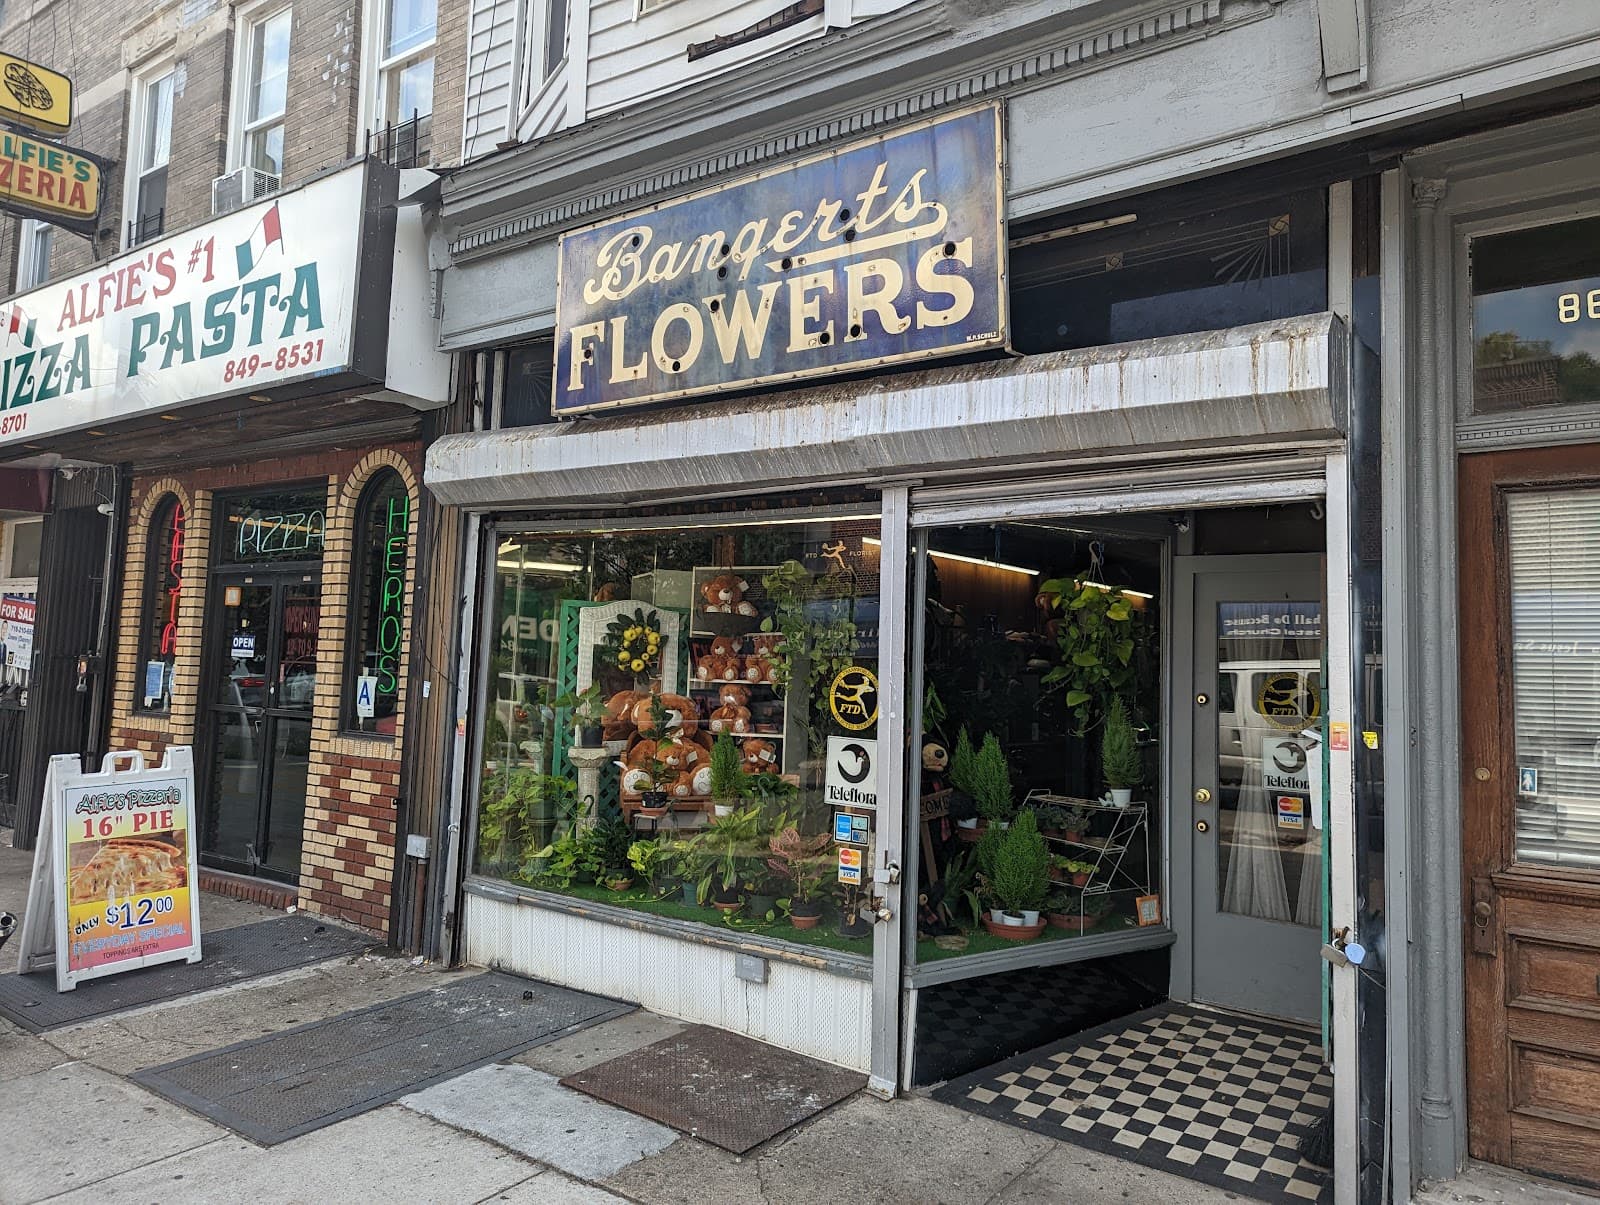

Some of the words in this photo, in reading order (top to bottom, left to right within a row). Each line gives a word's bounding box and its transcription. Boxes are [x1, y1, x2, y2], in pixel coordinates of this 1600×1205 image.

[0, 135, 90, 182] LFIE'S
[57, 248, 177, 332] ALFIE'S
[187, 235, 215, 283] #1
[127, 261, 324, 377] PASTA
[567, 236, 976, 392] FLOWERS
[223, 338, 324, 383] 849-8531
[239, 510, 326, 554] PIZZA
[378, 496, 410, 693] HEROS
[1, 604, 17, 618] FOR
[232, 636, 254, 649] OPEN
[358, 681, 371, 705] A
[839, 703, 861, 714] FTD
[1271, 707, 1297, 716] FTD
[76, 793, 126, 815] Alfie's
[126, 786, 181, 810] Pizzeria
[828, 785, 877, 806] Teleflora
[83, 815, 122, 839] 16"
[133, 809, 174, 832] PIE
[842, 870, 857, 879] VISA
[75, 916, 99, 935] ONLY
[138, 921, 187, 942] SPECIAL
[142, 942, 160, 952] EXTRA
